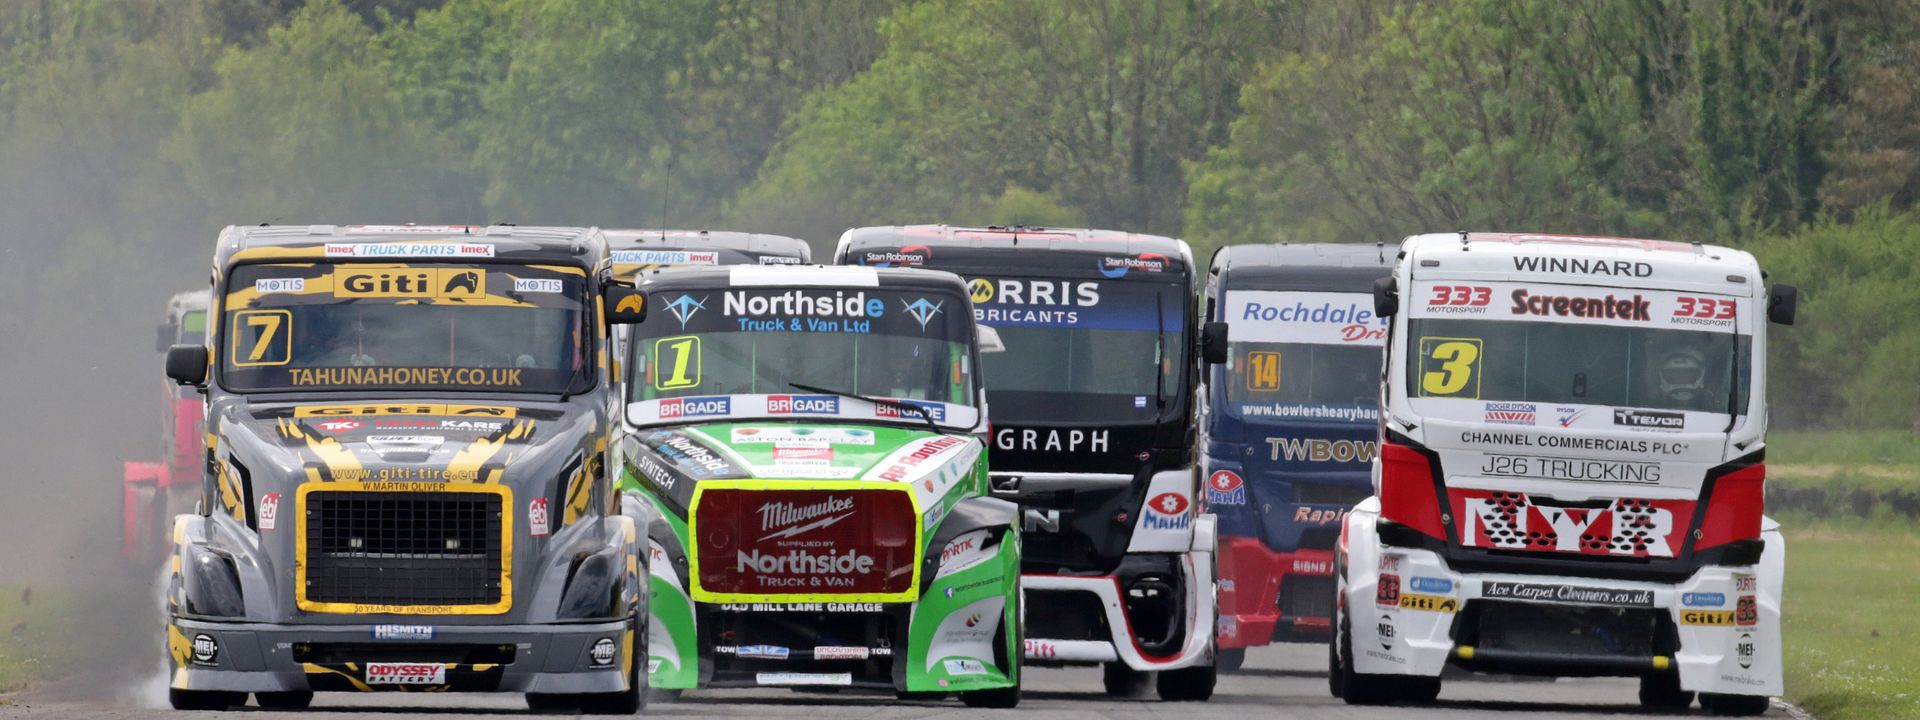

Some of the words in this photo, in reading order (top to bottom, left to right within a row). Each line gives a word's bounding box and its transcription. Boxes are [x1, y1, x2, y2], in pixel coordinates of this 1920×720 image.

[328, 245, 356, 255] imex
[362, 244, 407, 255] TRUCK
[411, 245, 455, 255] PARTS
[461, 246, 489, 255] imex
[611, 252, 641, 263] RUCK
[647, 253, 685, 263] PARTS
[690, 254, 714, 263] imex
[867, 252, 885, 261] Stan
[886, 253, 923, 261] Robinson
[1105, 257, 1124, 266] Stan
[1125, 258, 1162, 268] Robinson
[1513, 256, 1653, 278] WINNARD
[257, 280, 304, 291] MOTIS
[344, 274, 428, 293] Giti
[516, 280, 561, 291] MOTIS
[723, 290, 884, 318] Northside
[1429, 286, 1492, 306] 333
[1426, 306, 1487, 314] MOTORSPORT
[1511, 288, 1652, 321] Screentek
[1674, 297, 1736, 319] 333
[1243, 302, 1372, 325] Rochdale
[738, 318, 785, 331] Truck
[790, 319, 802, 331] &
[807, 319, 838, 332] Van
[844, 320, 870, 332] Ltd
[1671, 317, 1732, 327] MOTORSPORT
[247, 316, 281, 360] 7
[663, 340, 695, 387] 1
[1252, 354, 1278, 387] 14
[1422, 342, 1478, 395] 3
[289, 368, 522, 386] TAHUNAHONEY.CO.UK
[309, 406, 432, 415] Giti
[660, 401, 727, 416] BRIGADE
[768, 400, 835, 414] BRIGADE
[997, 429, 1110, 453] GRAPH
[1461, 431, 1533, 446] CHANNEL
[1538, 436, 1647, 453] COMMERCIALS
[1653, 442, 1682, 455] PLC
[665, 436, 730, 475] Northside
[878, 465, 907, 483] AP
[898, 434, 969, 466] Roofing
[332, 466, 479, 481] www.giti-tire.eu
[640, 455, 676, 490] SYNTECH
[1482, 457, 1528, 475] J26
[1537, 459, 1661, 482] TRUCKING
[363, 482, 411, 491] W.MARTIN
[412, 482, 445, 491] OLIVER
[755, 495, 855, 532] Milwaukee
[1143, 510, 1189, 530] MAHA
[737, 548, 874, 575] Northside
[757, 576, 806, 586] TRUCK
[810, 577, 821, 586] &
[825, 577, 855, 586] VAN
[1487, 583, 1510, 595] Ace
[1513, 584, 1554, 600] Carpet
[1557, 586, 1651, 604] Cleaners.co.uk
[406, 606, 452, 614] TRANSPORT
[721, 603, 749, 611] OLD
[753, 603, 785, 612] MILL
[788, 603, 823, 612] LANE
[827, 603, 883, 612] GARAGE
[1400, 596, 1433, 609] Giti
[1685, 612, 1723, 624] Giti
[1378, 623, 1395, 638] MEI
[194, 639, 215, 656] MEI
[593, 642, 615, 658] MEI
[1737, 643, 1754, 657] MEI
[369, 665, 440, 676] ODYSSEY
